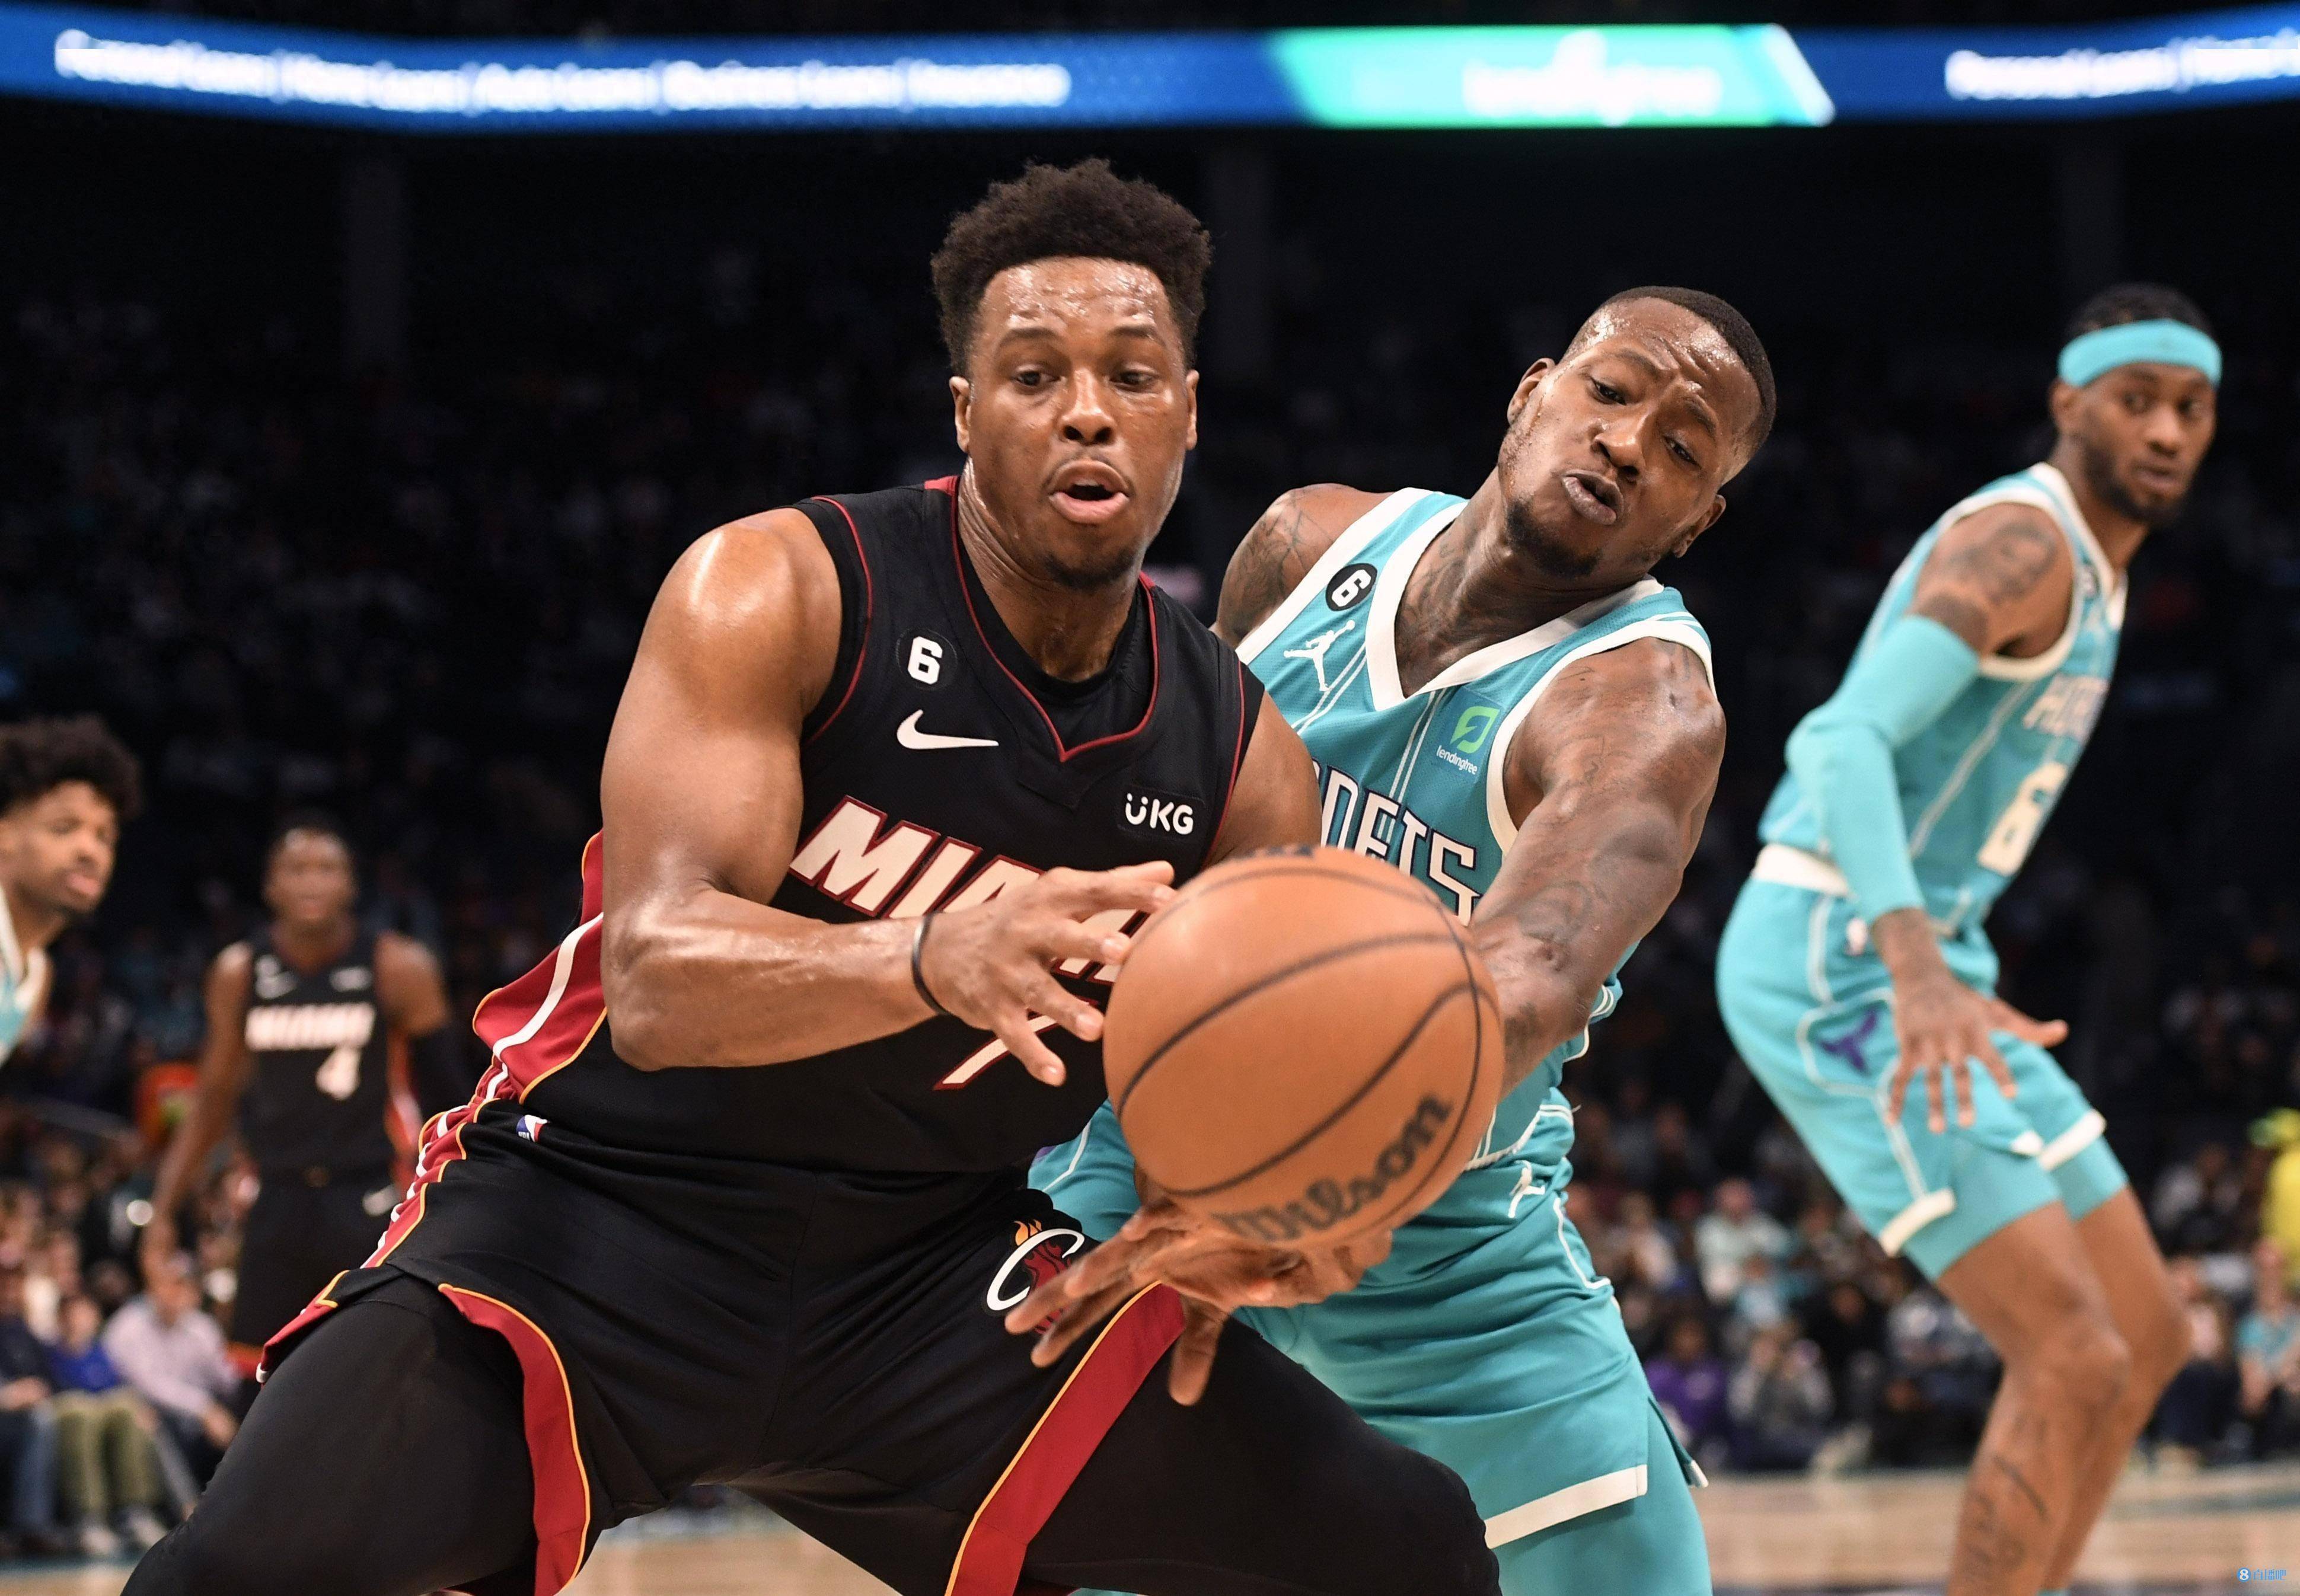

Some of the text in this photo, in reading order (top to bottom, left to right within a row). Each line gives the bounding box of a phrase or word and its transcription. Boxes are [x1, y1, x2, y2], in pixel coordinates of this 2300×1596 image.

[1331, 569, 1373, 608] 6
[907, 635, 943, 685] 6
[1435, 745, 1478, 775] lendingtree
[1312, 757, 1483, 927] NETS
[1210, 1093, 1453, 1243] Wilson
